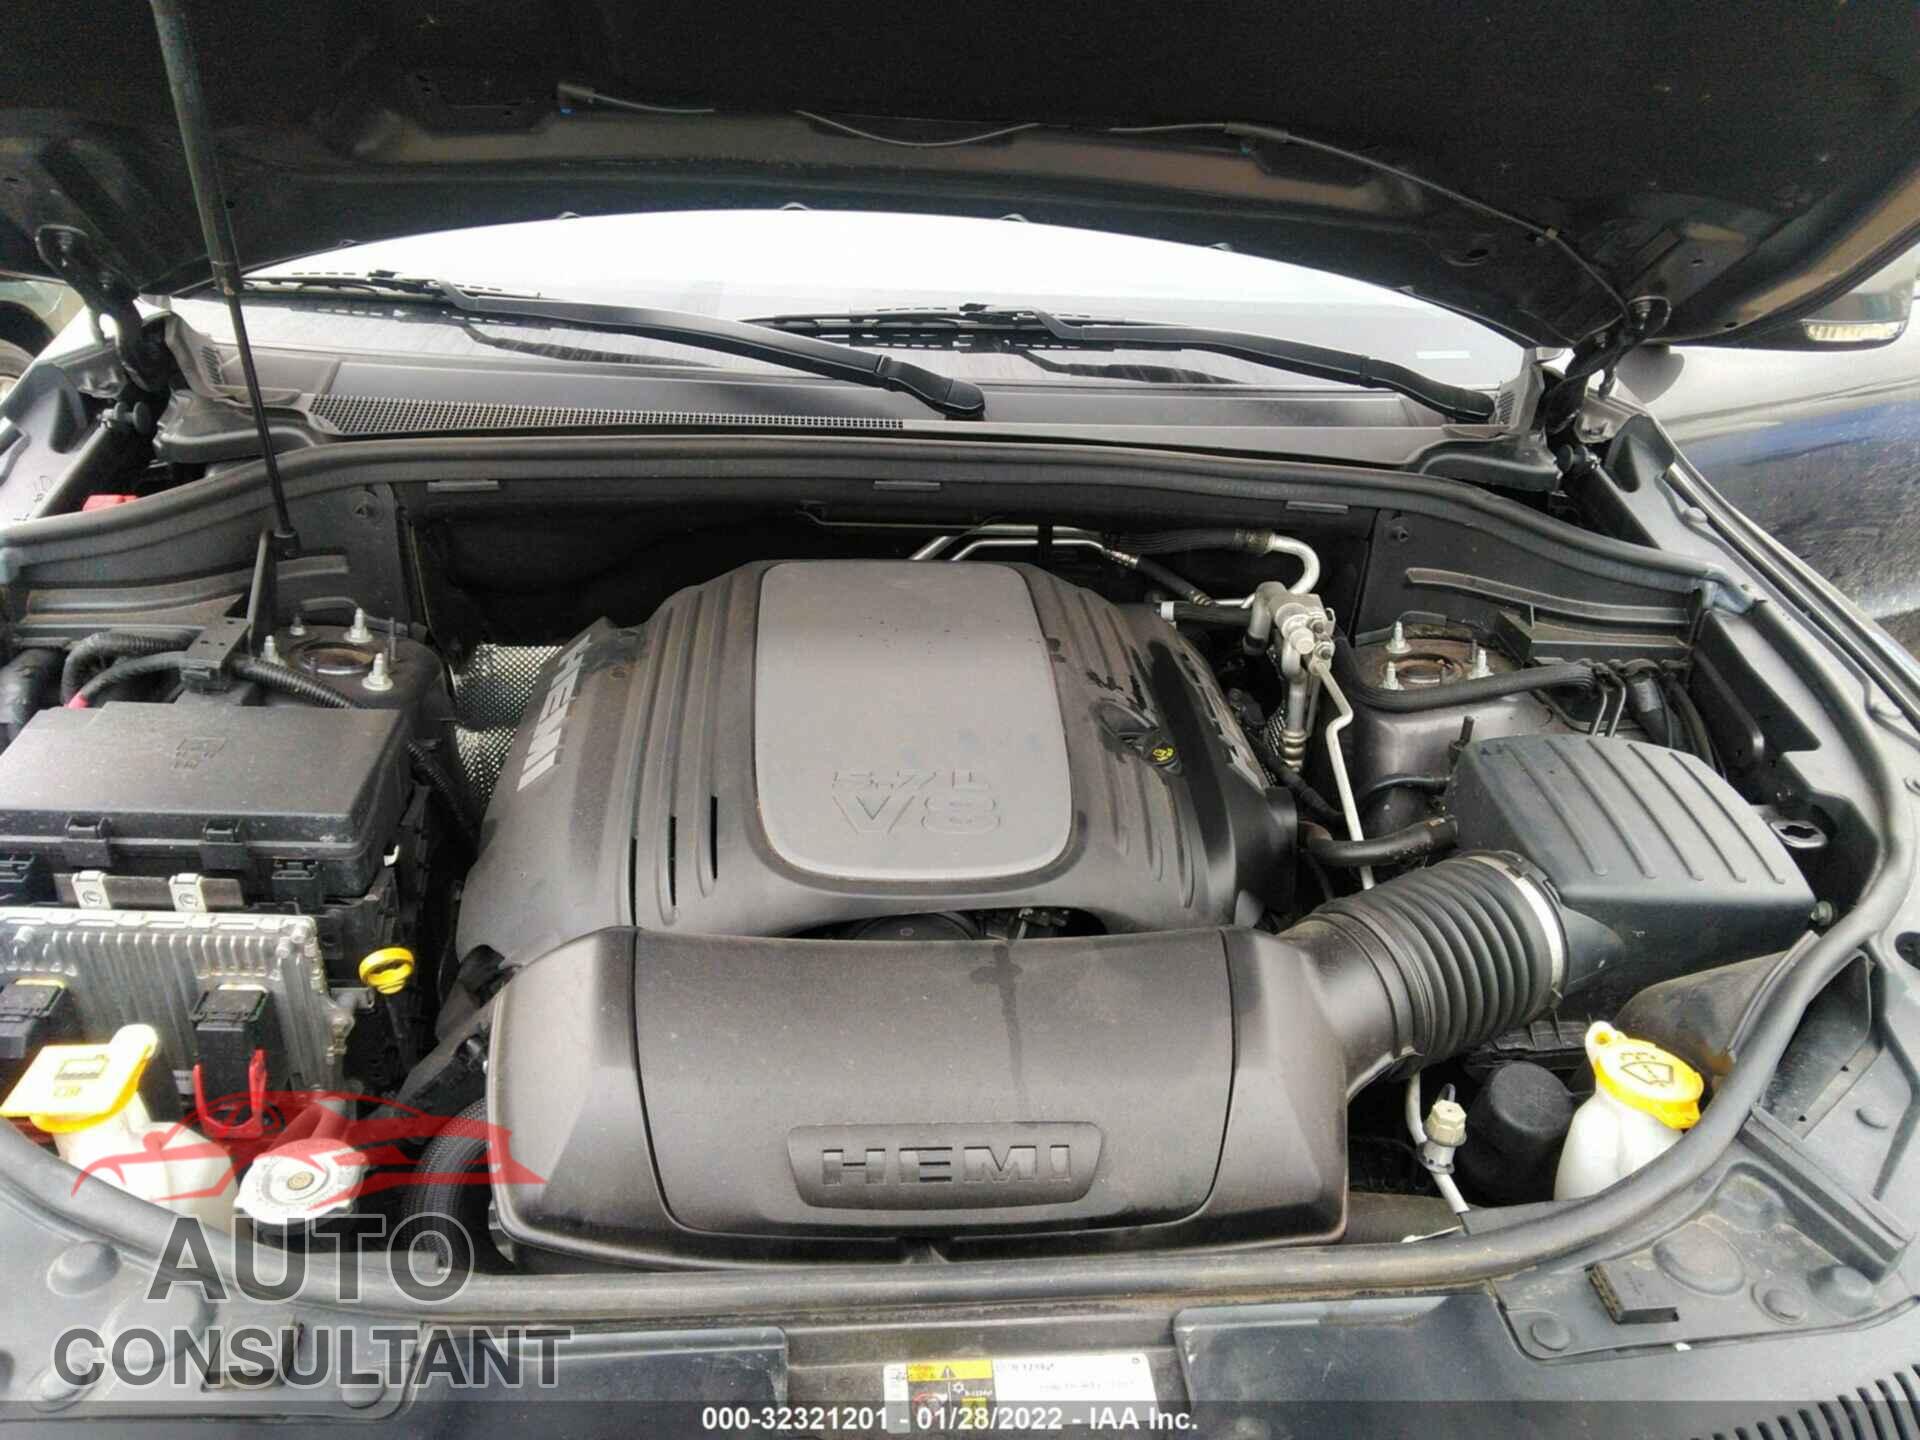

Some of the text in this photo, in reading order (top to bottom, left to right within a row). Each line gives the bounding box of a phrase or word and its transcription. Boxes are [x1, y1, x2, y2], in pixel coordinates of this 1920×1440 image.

[516, 633, 592, 793] HEMI
[831, 793, 1002, 835] V8
[821, 1144, 1071, 1185] HEMI
